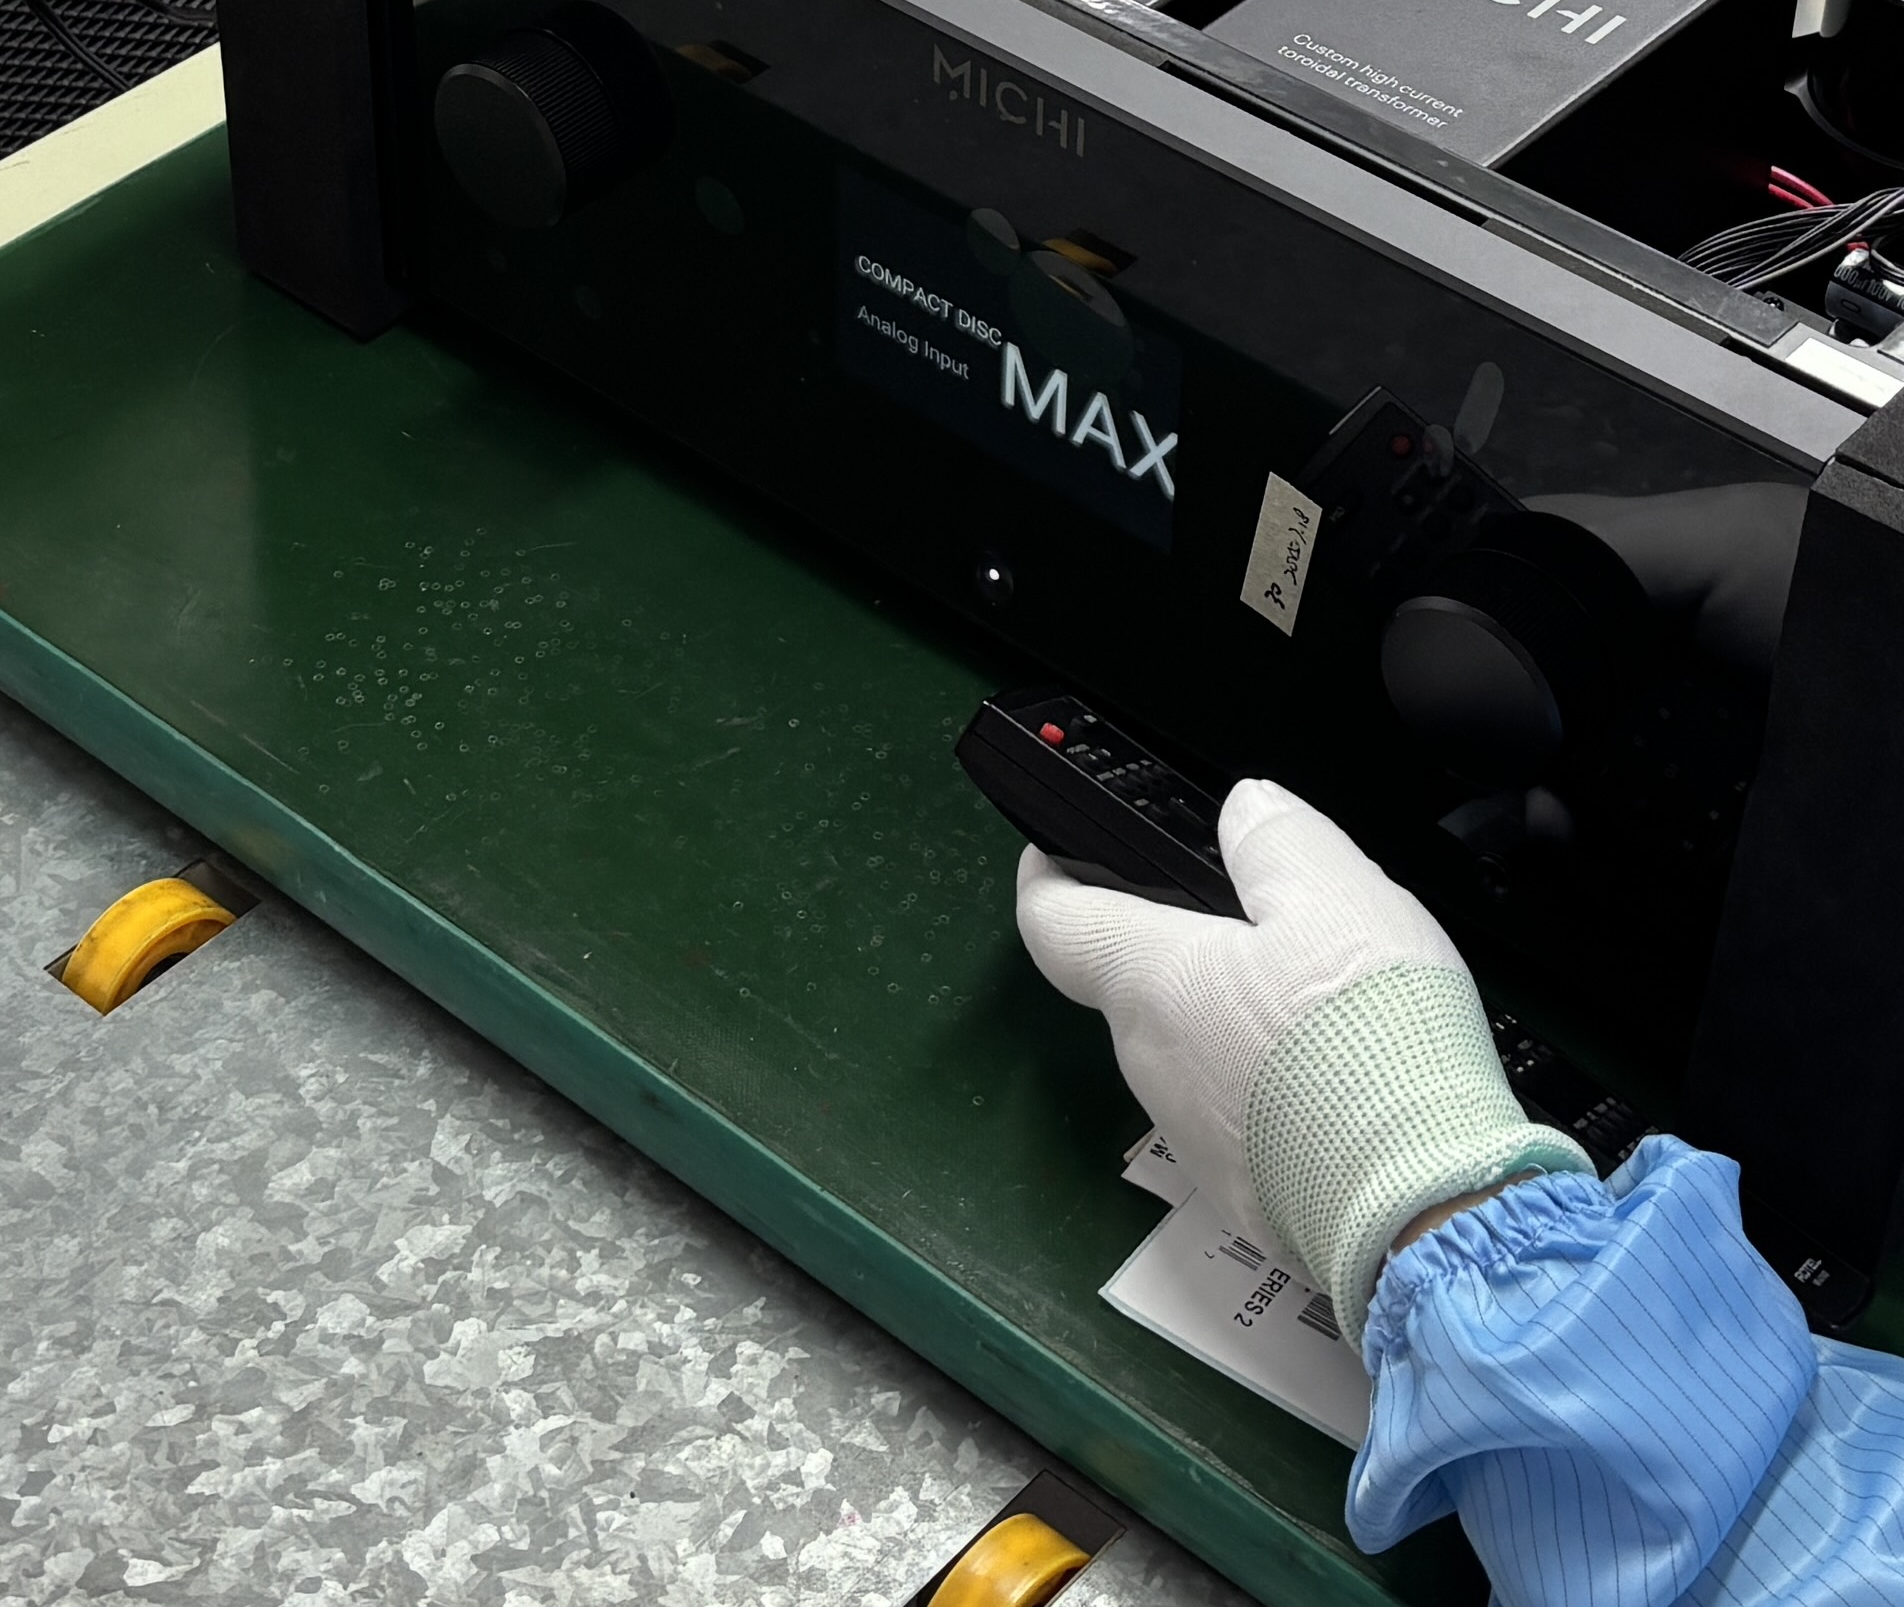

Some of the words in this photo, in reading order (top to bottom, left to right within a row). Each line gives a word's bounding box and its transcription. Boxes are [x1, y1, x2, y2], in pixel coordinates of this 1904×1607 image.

[932, 43, 1086, 158] MICHI
[1277, 45, 1345, 82] toroidal
[1343, 72, 1449, 130] transformer
[1293, 32, 1359, 70] Custom
[1359, 62, 1400, 90] high
[1398, 82, 1465, 118] current
[856, 254, 954, 320] COMPACT
[954, 307, 1004, 348] DISC
[857, 305, 919, 355] Analog
[924, 340, 972, 381] Input
[1001, 340, 1179, 501] MAX
[1244, 1267, 1292, 1317] ERIES
[1793, 1257, 1823, 1284] ROTEL
[1232, 1311, 1254, 1328] 2
